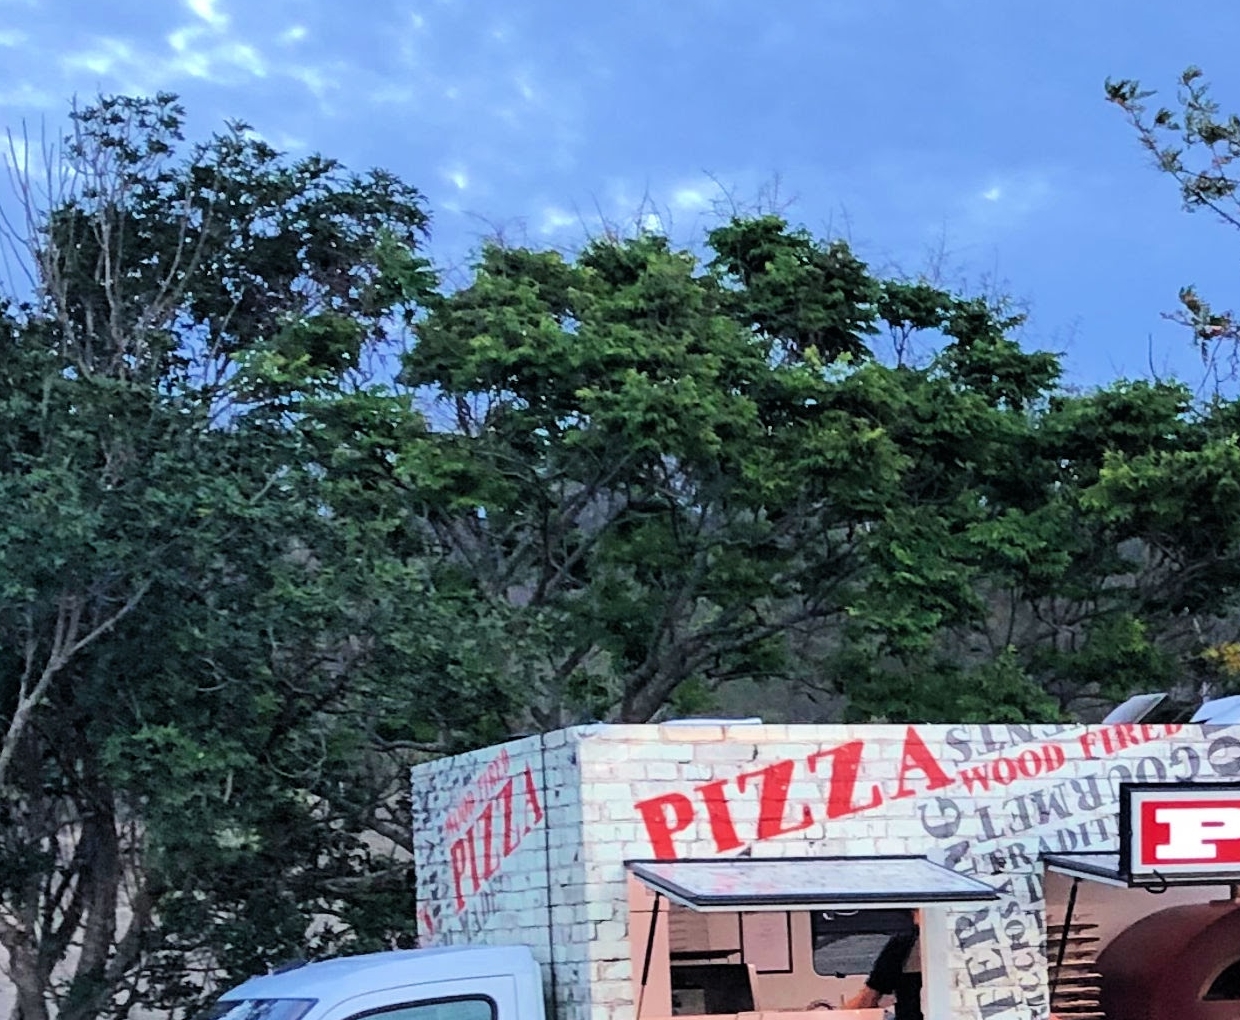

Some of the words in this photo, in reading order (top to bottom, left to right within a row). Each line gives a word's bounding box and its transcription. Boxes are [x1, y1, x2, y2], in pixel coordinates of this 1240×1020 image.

[634, 725, 953, 861] PIZZA
[956, 742, 1066, 795] WOOD
[451, 763, 543, 912] PIZZA
